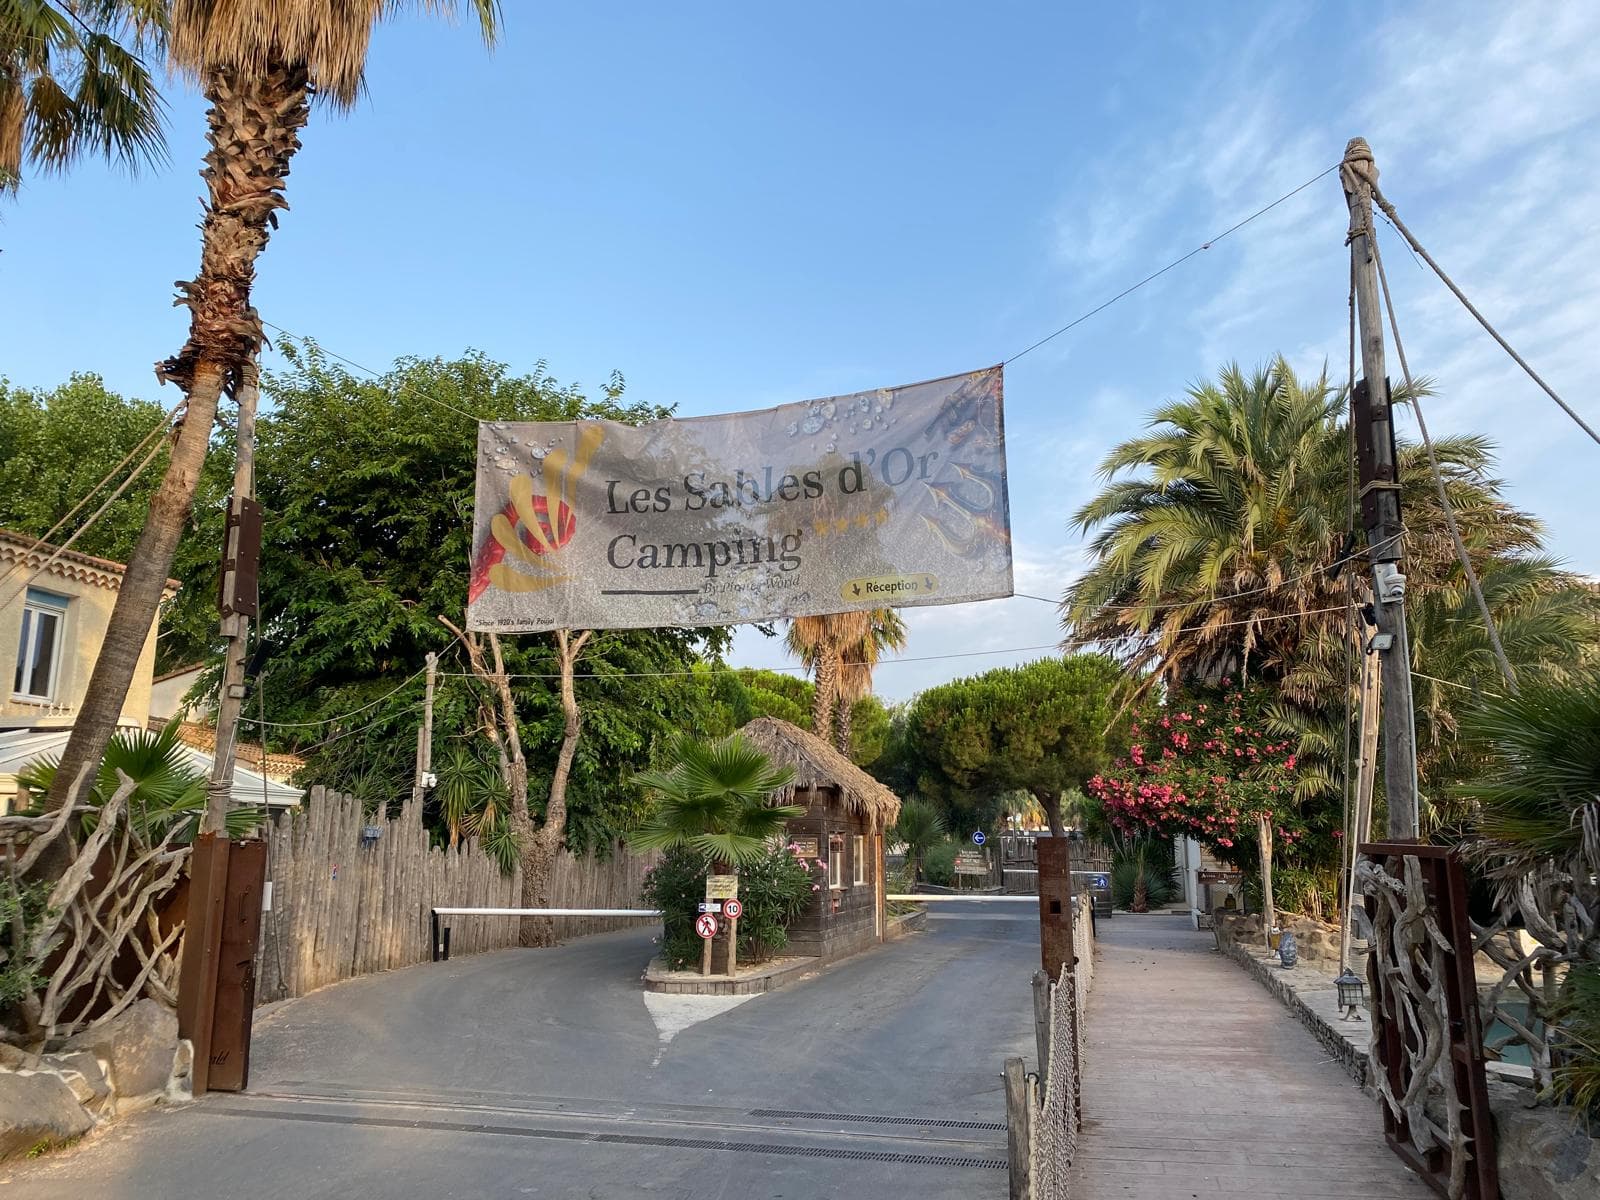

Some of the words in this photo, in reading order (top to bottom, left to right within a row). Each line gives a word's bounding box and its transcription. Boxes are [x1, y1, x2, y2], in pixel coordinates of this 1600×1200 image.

[606, 480, 671, 514] Les
[684, 464, 824, 512] Sables
[606, 529, 803, 578] Camping
[704, 583, 719, 596] By
[766, 574, 801, 589] World
[866, 579, 918, 595] Réception
[728, 904, 738, 913] 10
